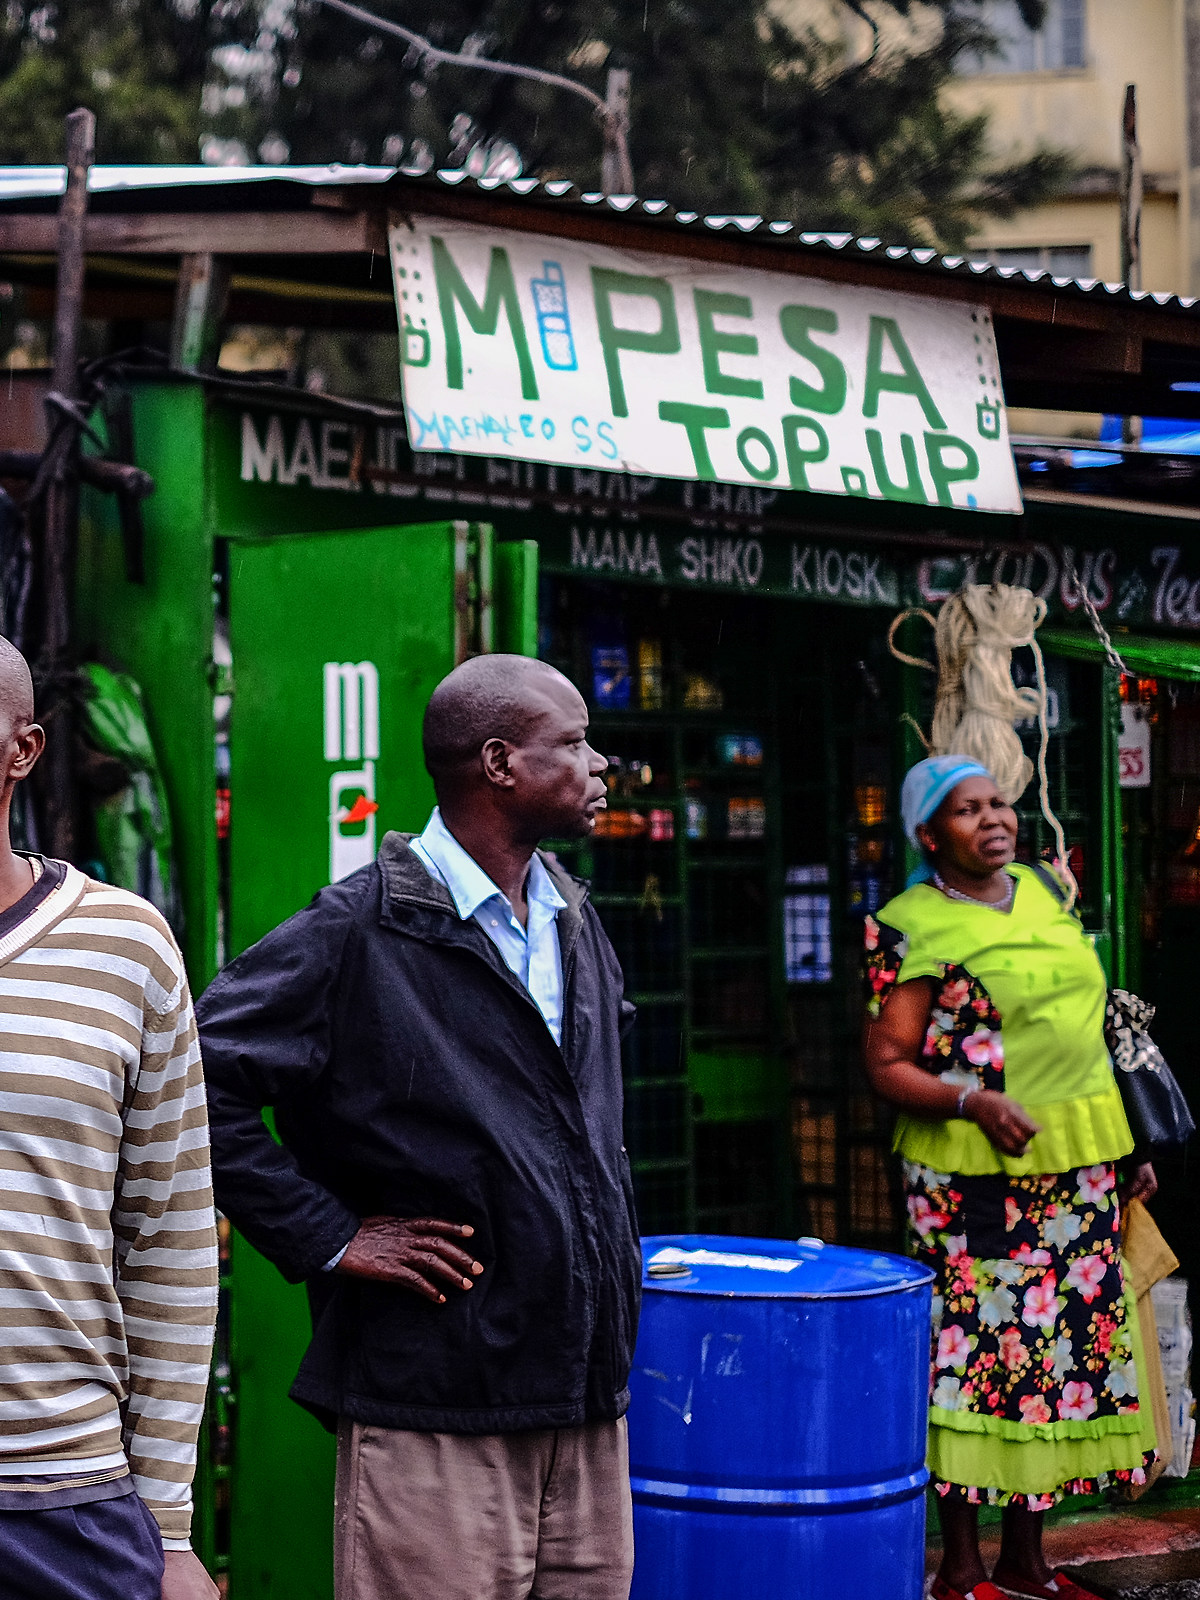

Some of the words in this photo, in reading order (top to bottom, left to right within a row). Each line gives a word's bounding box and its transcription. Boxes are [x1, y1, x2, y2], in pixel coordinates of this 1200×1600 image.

[589, 265, 948, 431] PESA
[570, 525, 664, 584] MAMA
[680, 536, 764, 588] SHIKO
[791, 543, 890, 604] KIOSK
